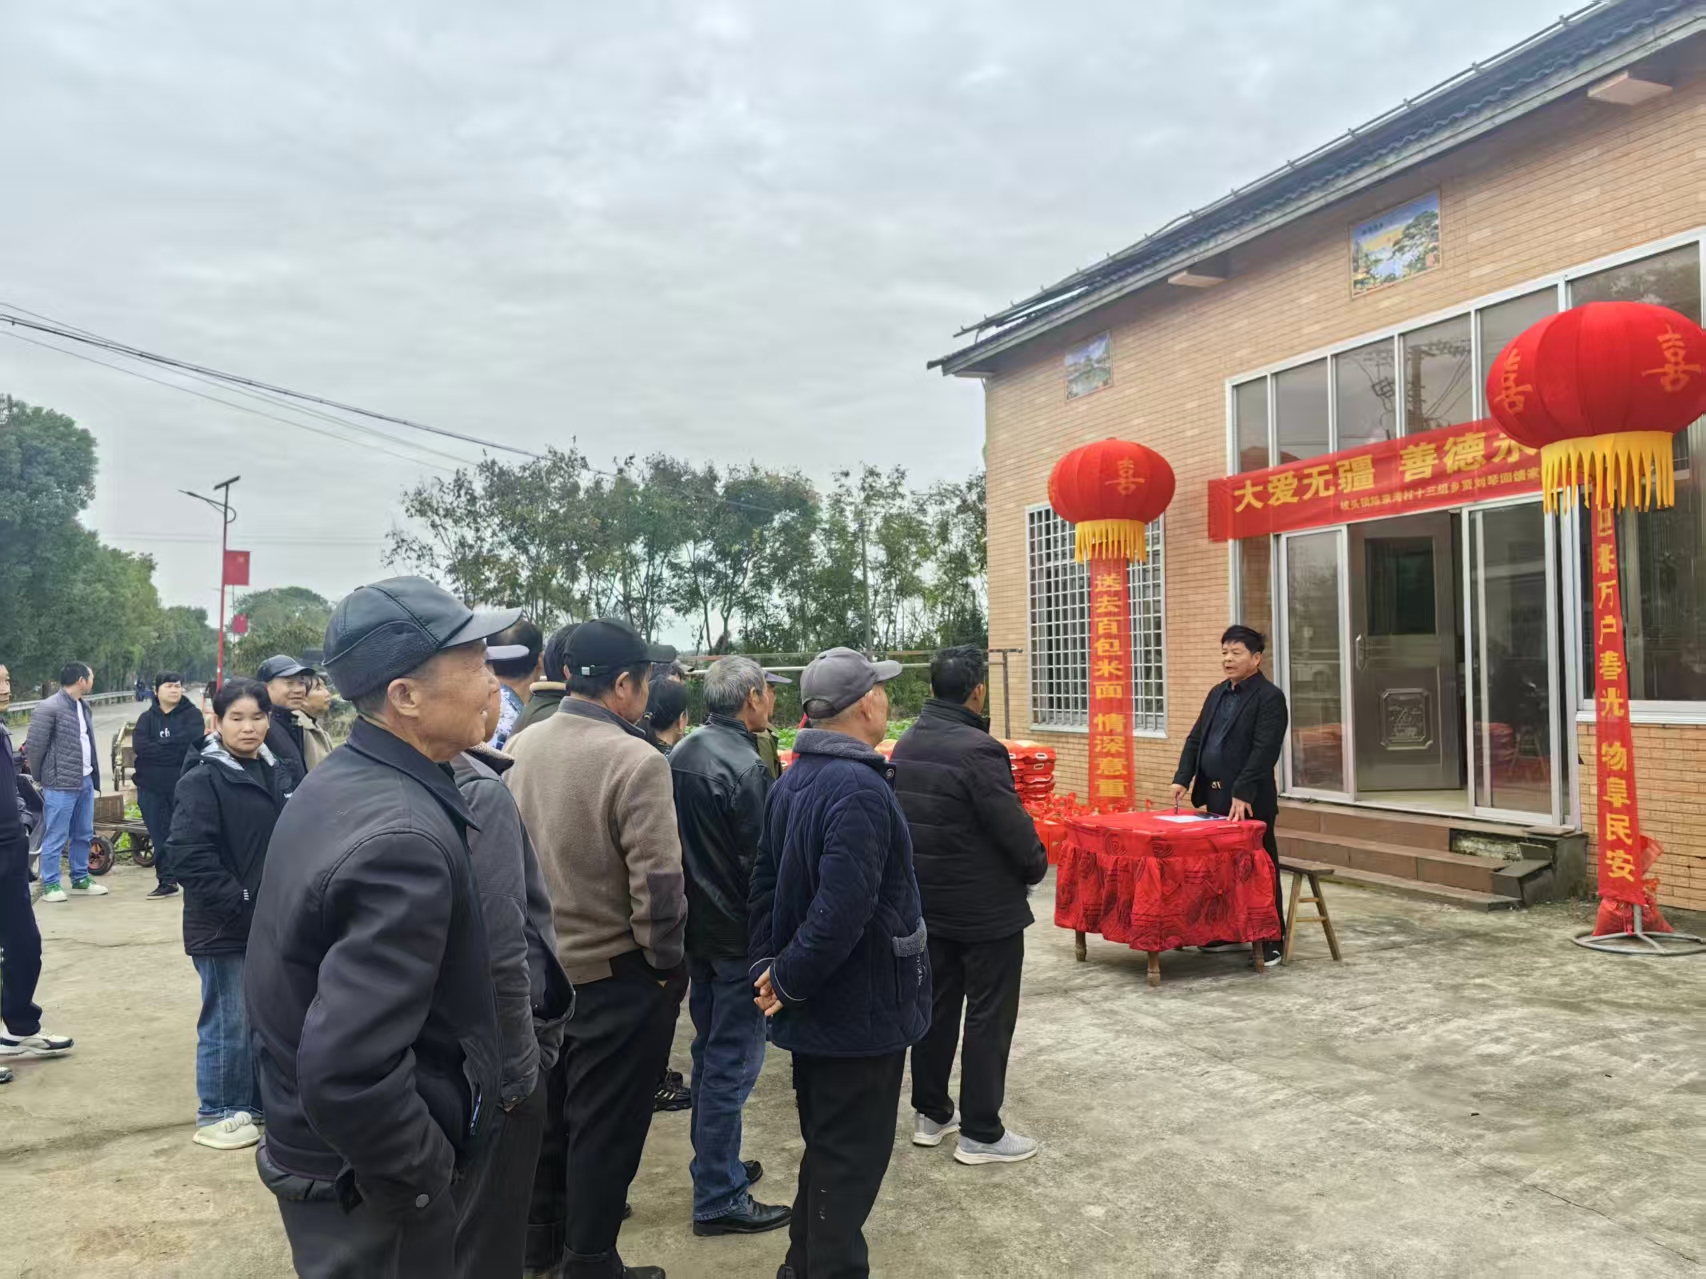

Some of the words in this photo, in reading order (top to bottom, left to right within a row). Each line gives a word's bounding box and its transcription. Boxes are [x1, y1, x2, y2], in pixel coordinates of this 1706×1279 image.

[1641, 323, 1702, 393] 喜
[1104, 457, 1145, 496] 喜
[1233, 454, 1375, 513] 大爱无疆
[1093, 573, 1124, 699] 送去百包米面
[1093, 713, 1129, 798] 情深意重
[1600, 741, 1635, 883] 物阜民安
